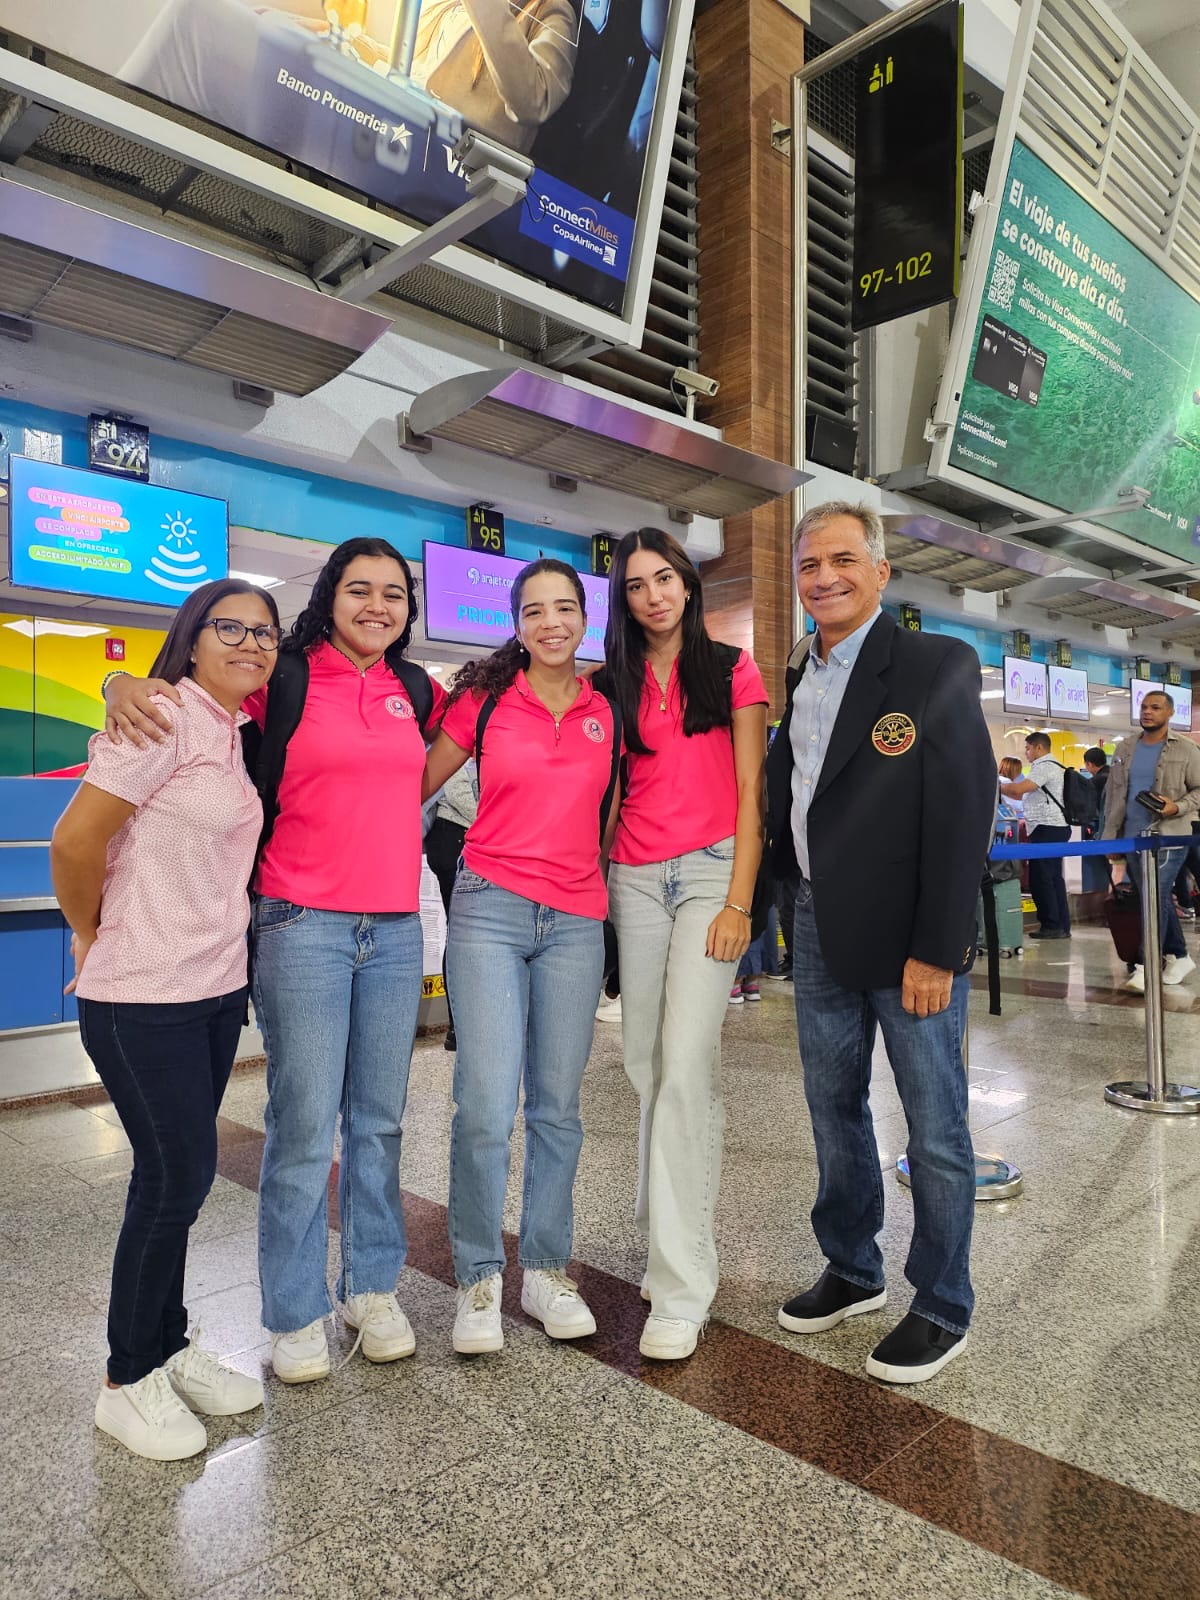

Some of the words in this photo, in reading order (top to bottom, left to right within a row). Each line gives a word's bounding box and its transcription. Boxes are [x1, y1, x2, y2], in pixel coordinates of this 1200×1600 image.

[276, 68, 321, 101] Banco
[321, 90, 388, 135] Promerica
[539, 194, 619, 245] ConnectMiles
[1009, 178, 1024, 208] El
[1024, 195, 1054, 234] viaje
[1055, 220, 1071, 247] de
[1072, 234, 1090, 263] tus
[1090, 252, 1127, 293] sueños
[553, 223, 604, 255] CopaAirlines
[860, 251, 932, 297] 97-102
[1002, 219, 1018, 243] se
[1019, 232, 1078, 288] construye
[1098, 292, 1107, 311] a
[1022, 278, 1045, 302] Solicita
[1044, 294, 1051, 306] tu
[1018, 297, 1036, 315] millas
[1036, 309, 1048, 323] con
[1048, 315, 1057, 330] tus
[107, 443, 144, 476] 94
[64, 540, 77, 548] EN
[479, 525, 501, 550] 95
[603, 554, 612, 574] 9
[457, 604, 514, 629] PRIORI
[909, 620, 919, 631] 98
